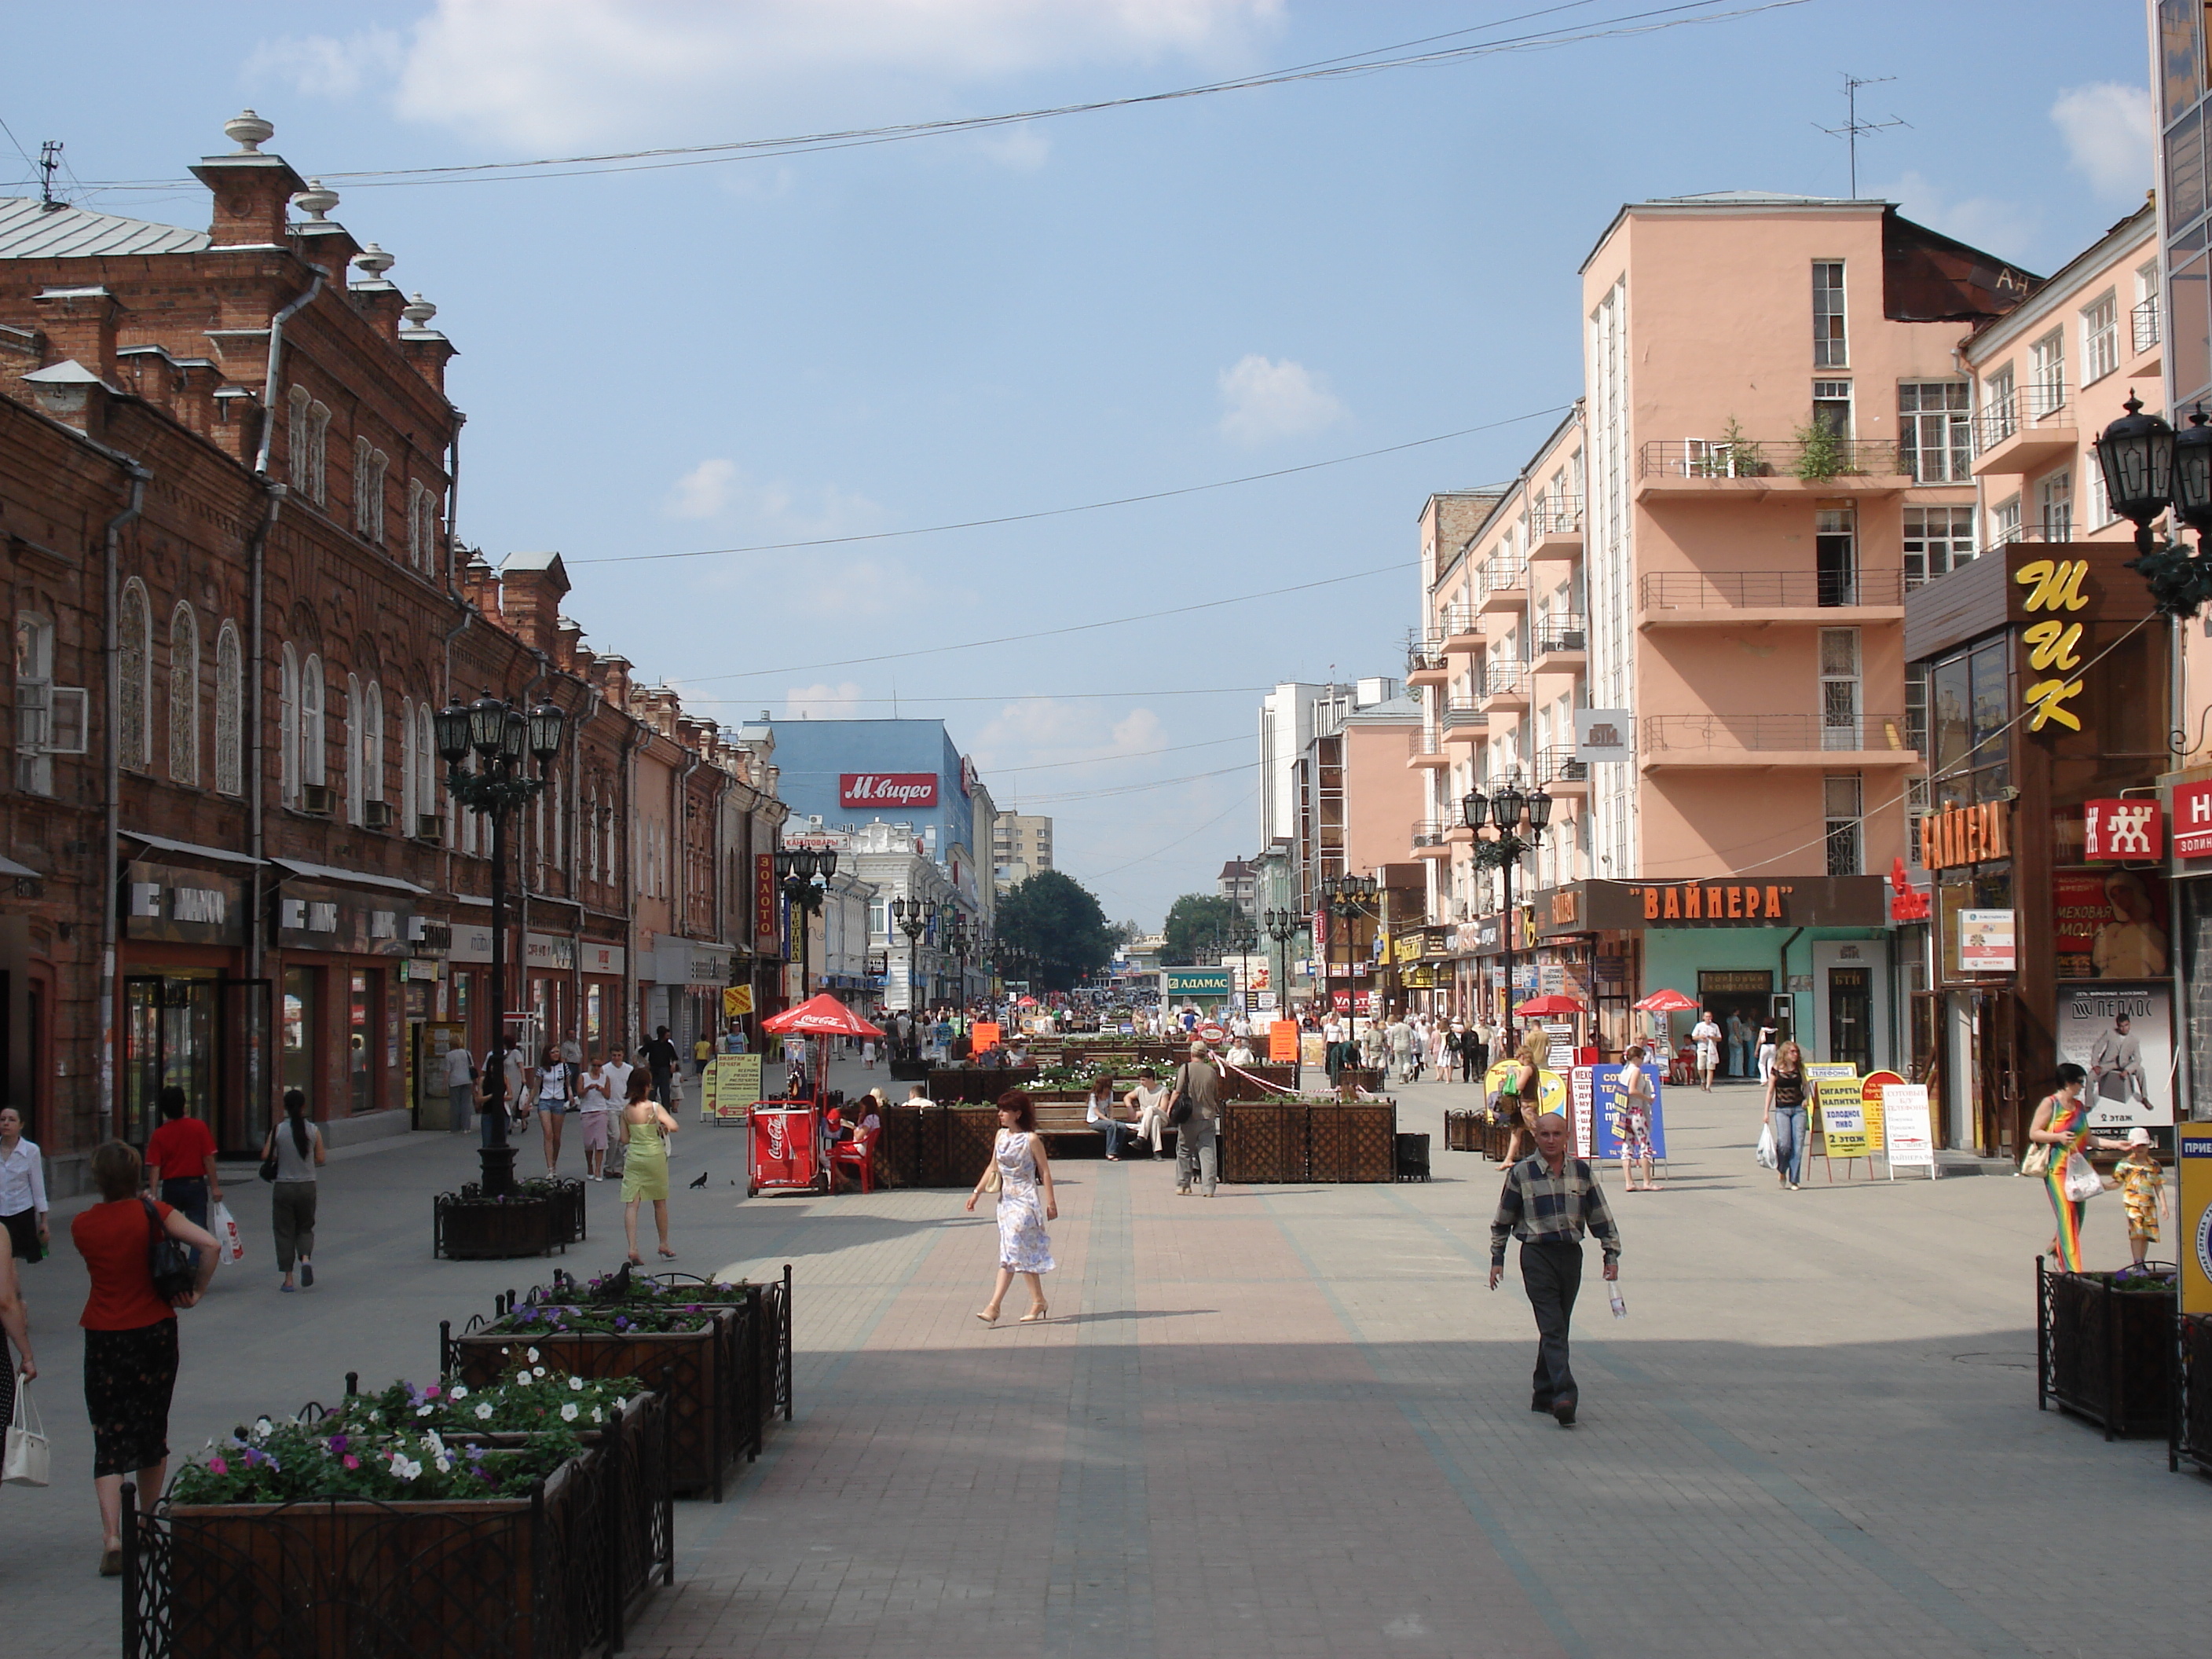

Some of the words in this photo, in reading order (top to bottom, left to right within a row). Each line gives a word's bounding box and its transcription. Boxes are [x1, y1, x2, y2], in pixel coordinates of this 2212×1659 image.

[2192, 793, 2212, 823] Н
[760, 857, 771, 933] ЗОЛОТО
[2054, 906, 2113, 919] МЕХОВАЯ
[2056, 921, 2106, 939] МОДА
[1181, 978, 1228, 988] АДАМАС
[1826, 1110, 1860, 1119] ХОЛОДНОЕ
[767, 1116, 783, 1159] Coca-Cola
[1829, 1134, 1836, 1143] 2
